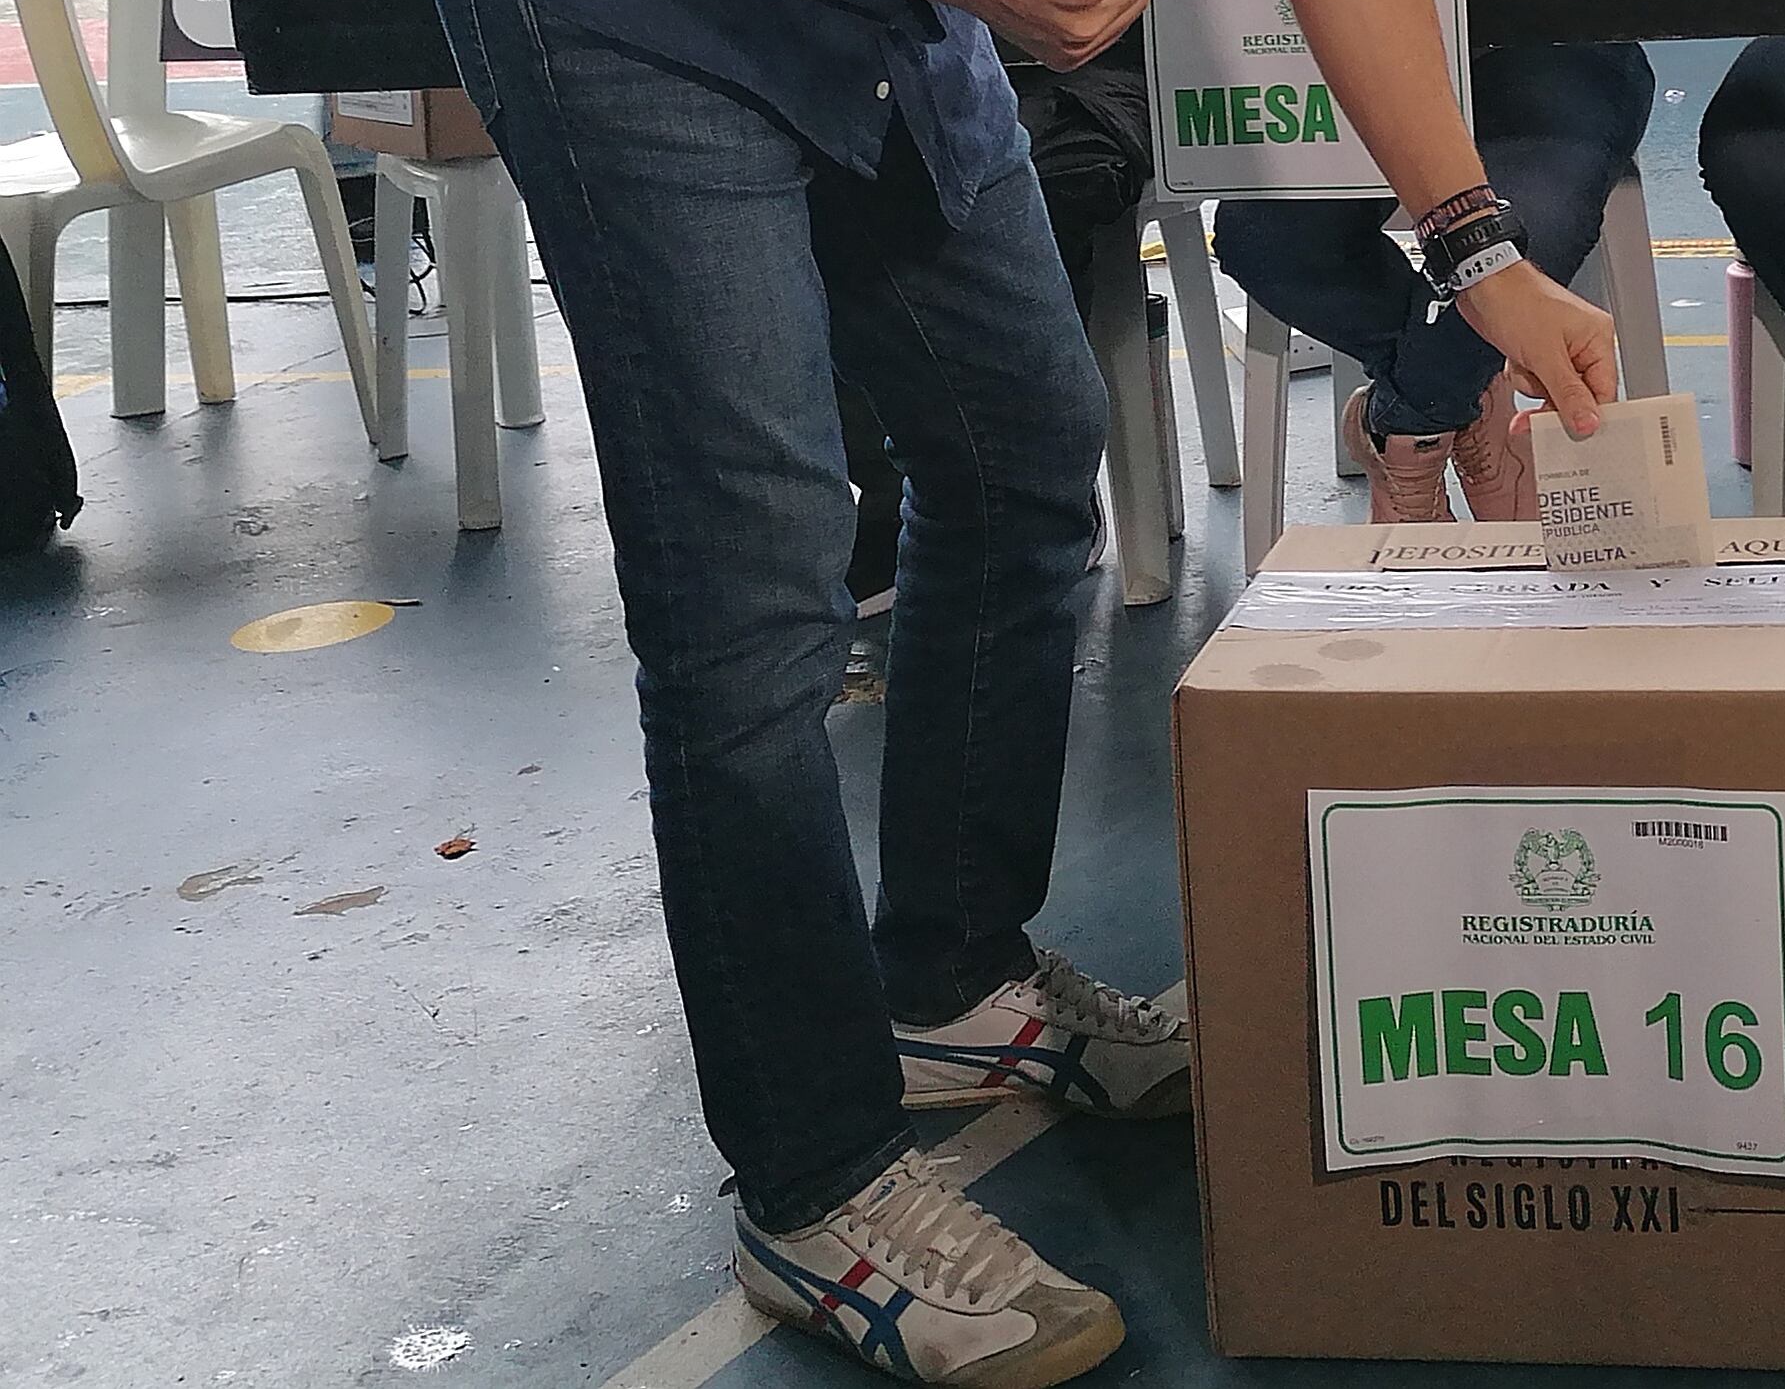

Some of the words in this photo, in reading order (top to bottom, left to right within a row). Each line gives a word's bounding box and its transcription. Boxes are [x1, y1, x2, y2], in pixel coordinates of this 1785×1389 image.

[1175, 85, 1339, 146] MESA
[1556, 547, 1627, 565] VUELTA
[1462, 910, 1654, 933] REGISTRADURÍA
[1462, 934, 1529, 945] NACIONAL
[1533, 935, 1560, 945] DEL
[1564, 935, 1616, 946] ESTADO
[1620, 934, 1656, 945] CIVIL
[1358, 989, 1608, 1085] MESA
[1645, 991, 1763, 1091] 16
[1380, 1180, 1456, 1229] DEL
[1466, 1182, 1591, 1232] SIGLO
[1611, 1185, 1680, 1233] XXI
